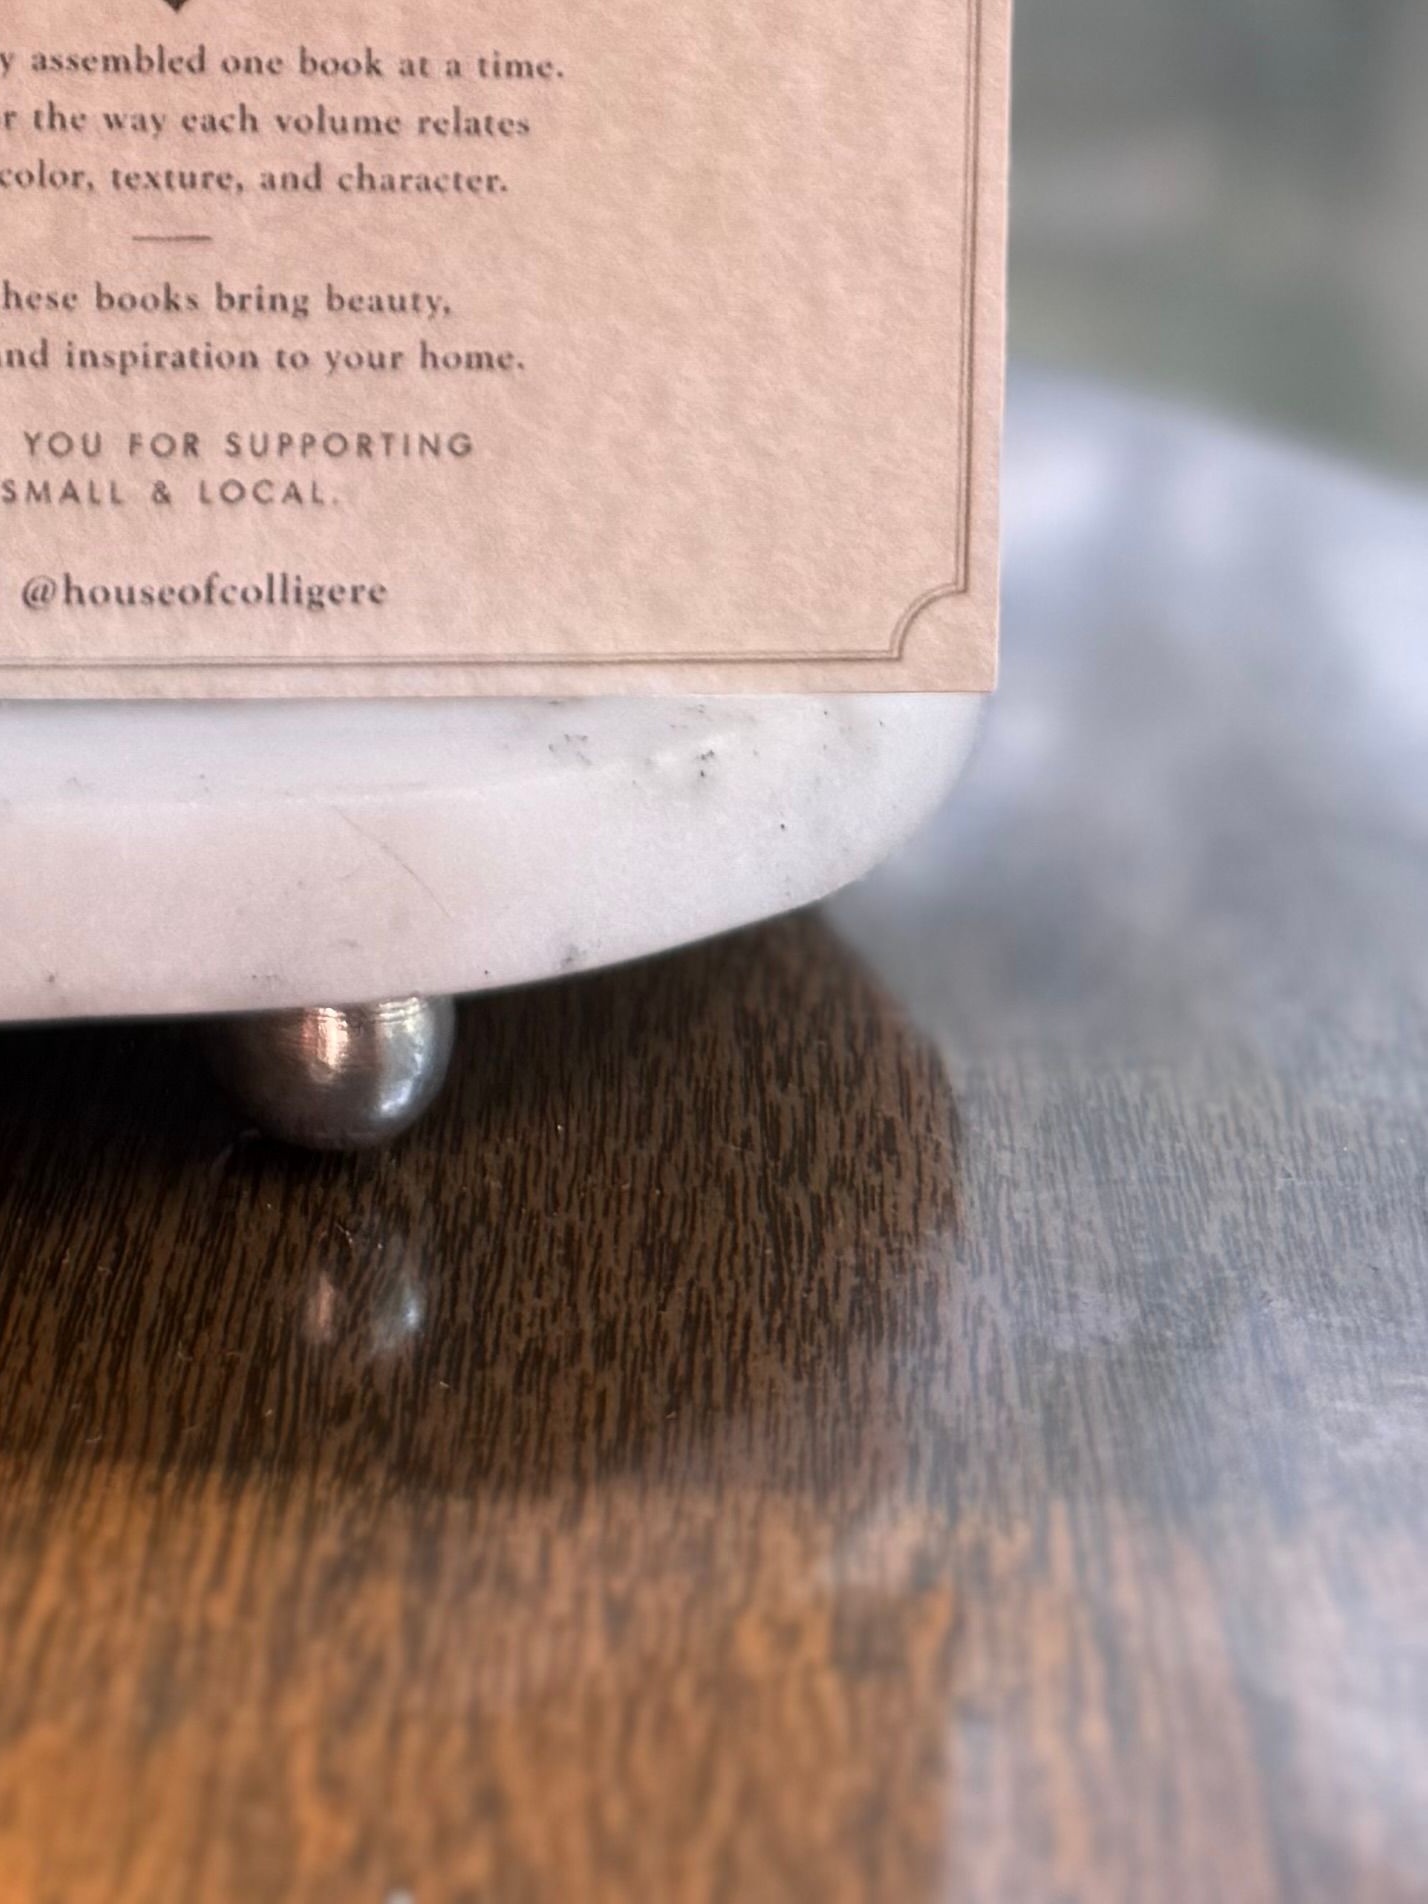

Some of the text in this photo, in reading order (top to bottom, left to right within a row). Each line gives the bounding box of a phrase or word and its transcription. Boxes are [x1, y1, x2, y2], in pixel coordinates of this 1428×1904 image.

[31, 42, 207, 78] assembled
[220, 55, 284, 78] one
[299, 46, 384, 80] book
[398, 56, 430, 80] at
[445, 58, 463, 80] a
[477, 50, 565, 81] time.
[33, 100, 87, 134] the
[101, 110, 166, 142] way
[180, 102, 260, 136] each
[274, 103, 402, 137] volume
[417, 105, 531, 139] relates
[111, 164, 245, 196] texture,
[259, 161, 323, 193] and
[336, 161, 508, 195] character.
[95, 280, 200, 315] books
[215, 281, 311, 321] bring
[326, 282, 452, 322] beauty,
[65, 338, 260, 380] inspiration
[275, 346, 311, 373] to
[324, 348, 405, 379] your
[419, 340, 526, 374] home.
[23, 431, 103, 460] YOU
[128, 431, 201, 460] FOR
[225, 431, 474, 461] SUPPORTING
[1, 478, 340, 508] SMALL & LOCAL.
[21, 570, 388, 615] @houseofcolligere
